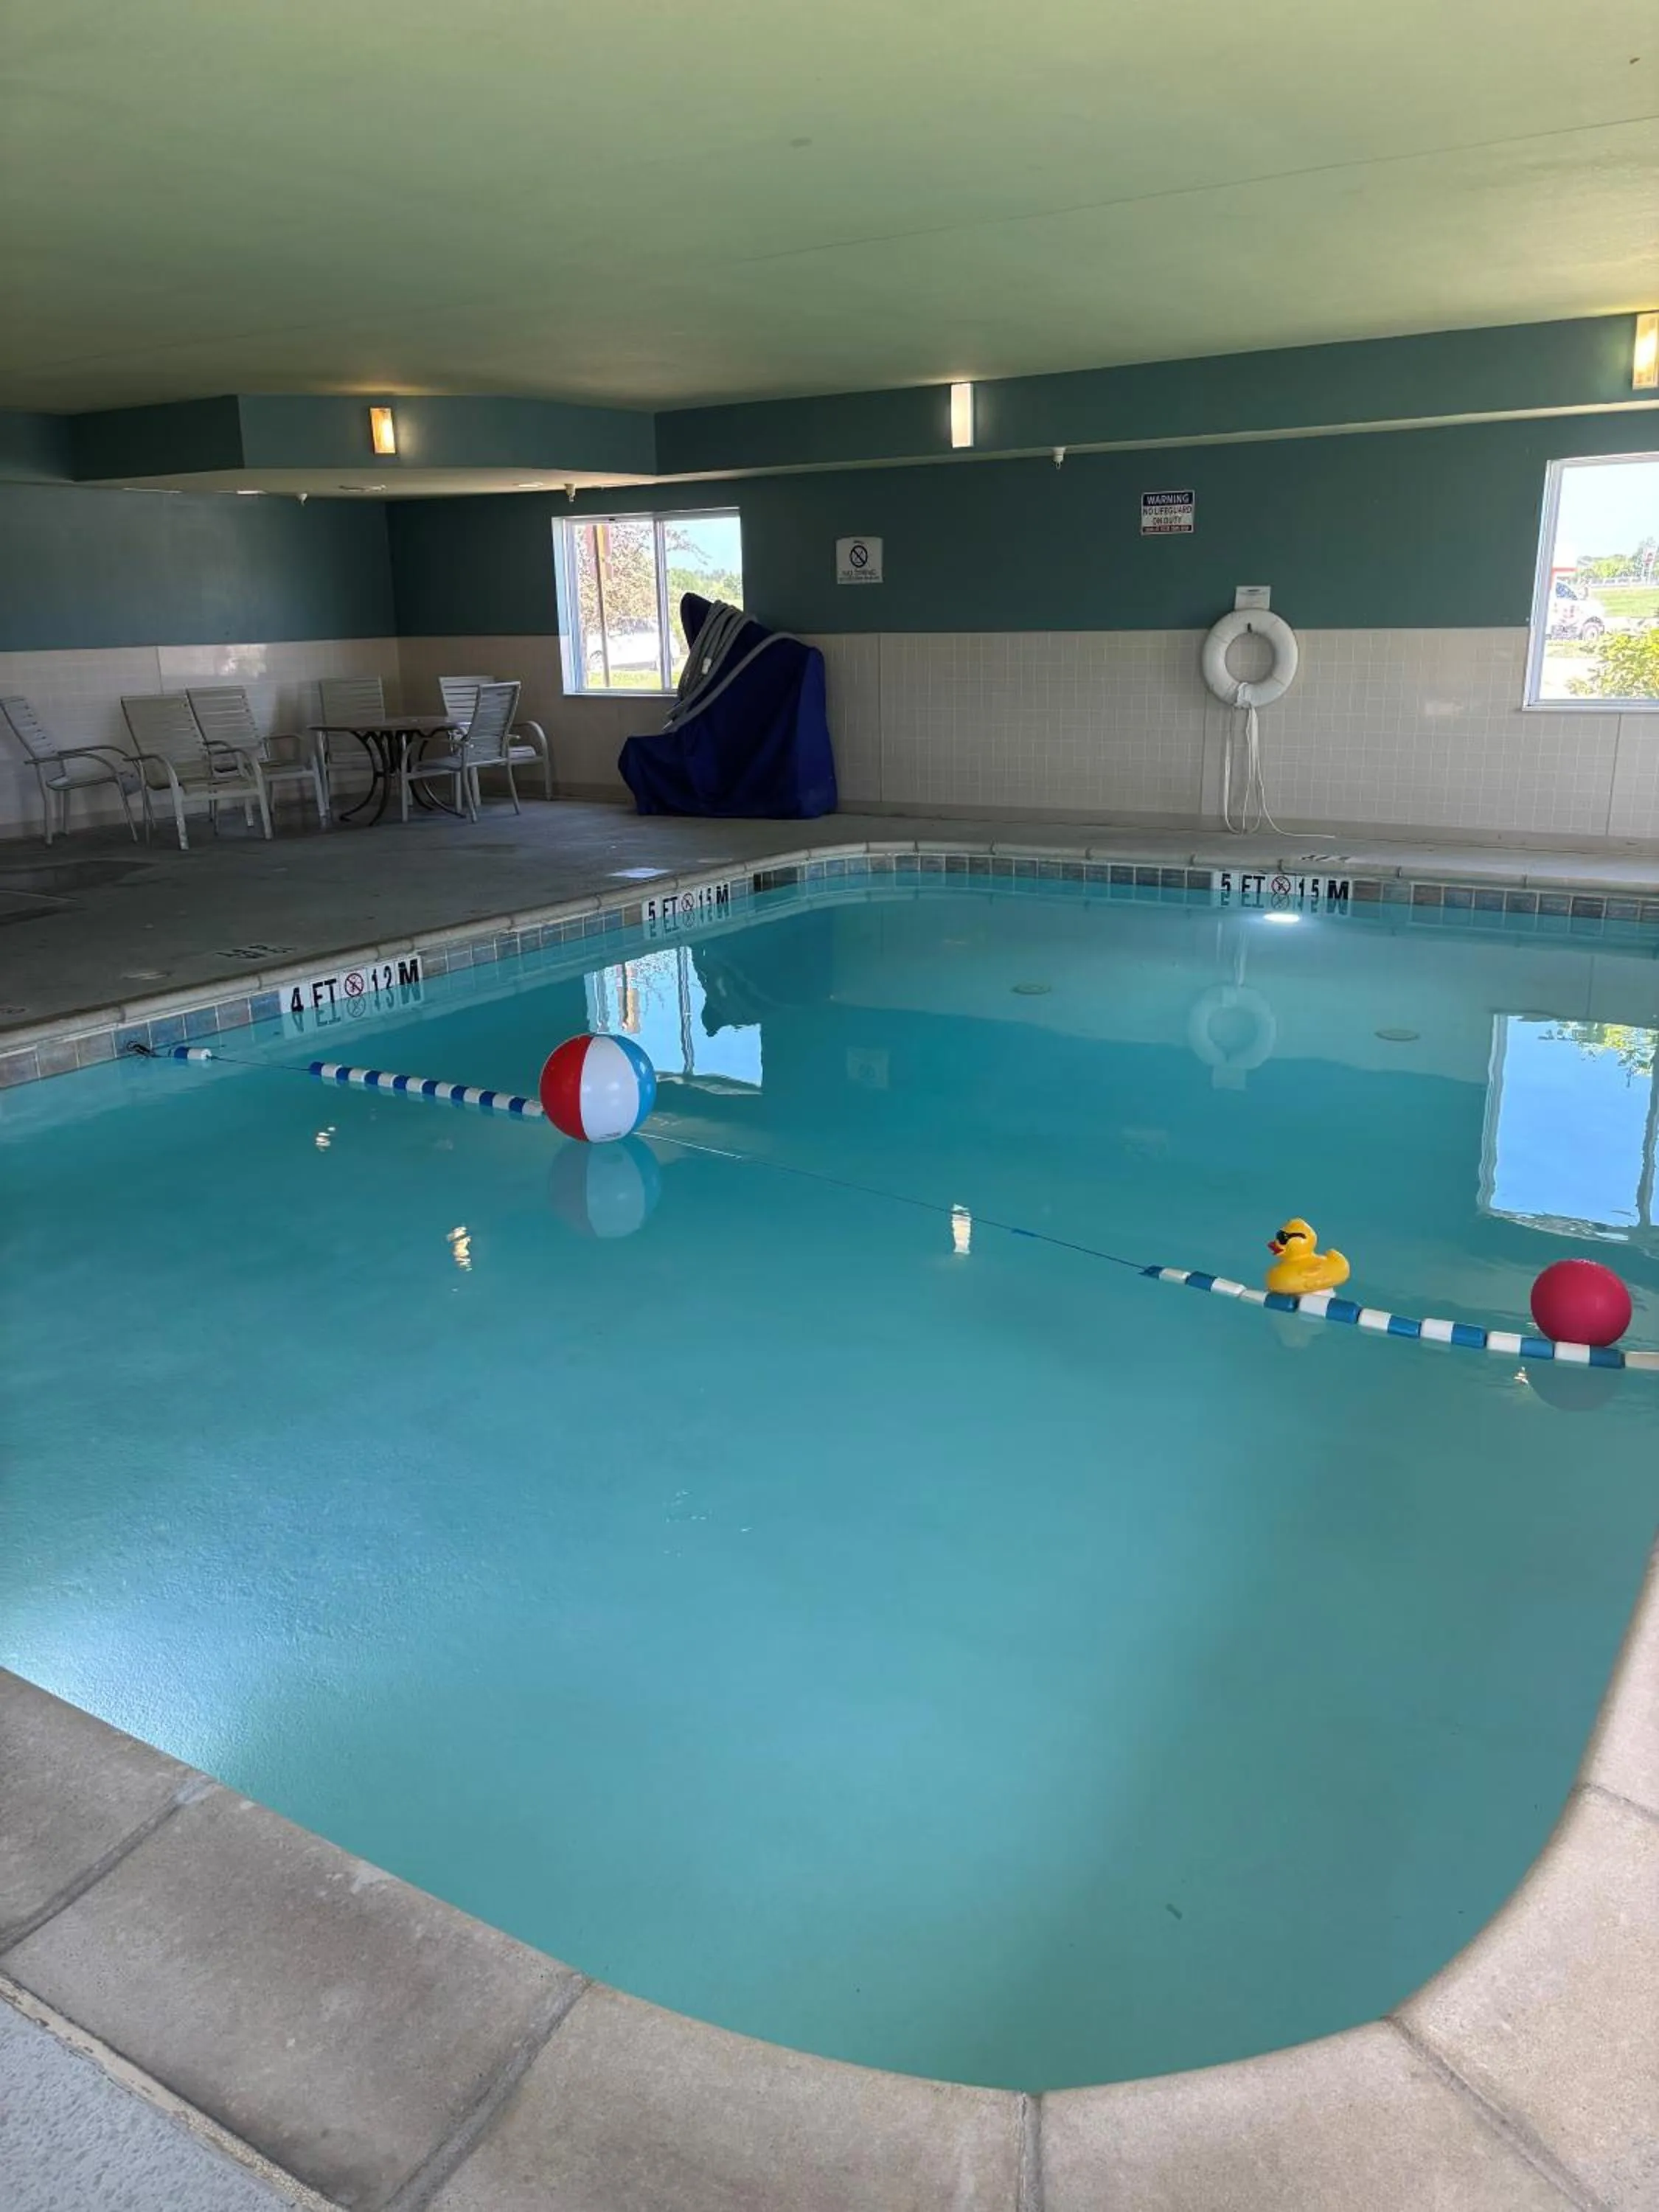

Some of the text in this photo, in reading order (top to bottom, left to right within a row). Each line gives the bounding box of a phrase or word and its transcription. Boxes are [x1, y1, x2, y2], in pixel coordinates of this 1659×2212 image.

[1147, 493, 1189, 505] WARNING
[648, 900, 655, 921] 5
[663, 896, 678, 917] FT
[717, 883, 728, 905] M
[1221, 873, 1231, 891] 5
[1241, 874, 1266, 894] FT
[1328, 880, 1349, 900] M
[291, 987, 304, 1012] 4
[312, 978, 337, 1008] FT
[398, 959, 420, 986] M
